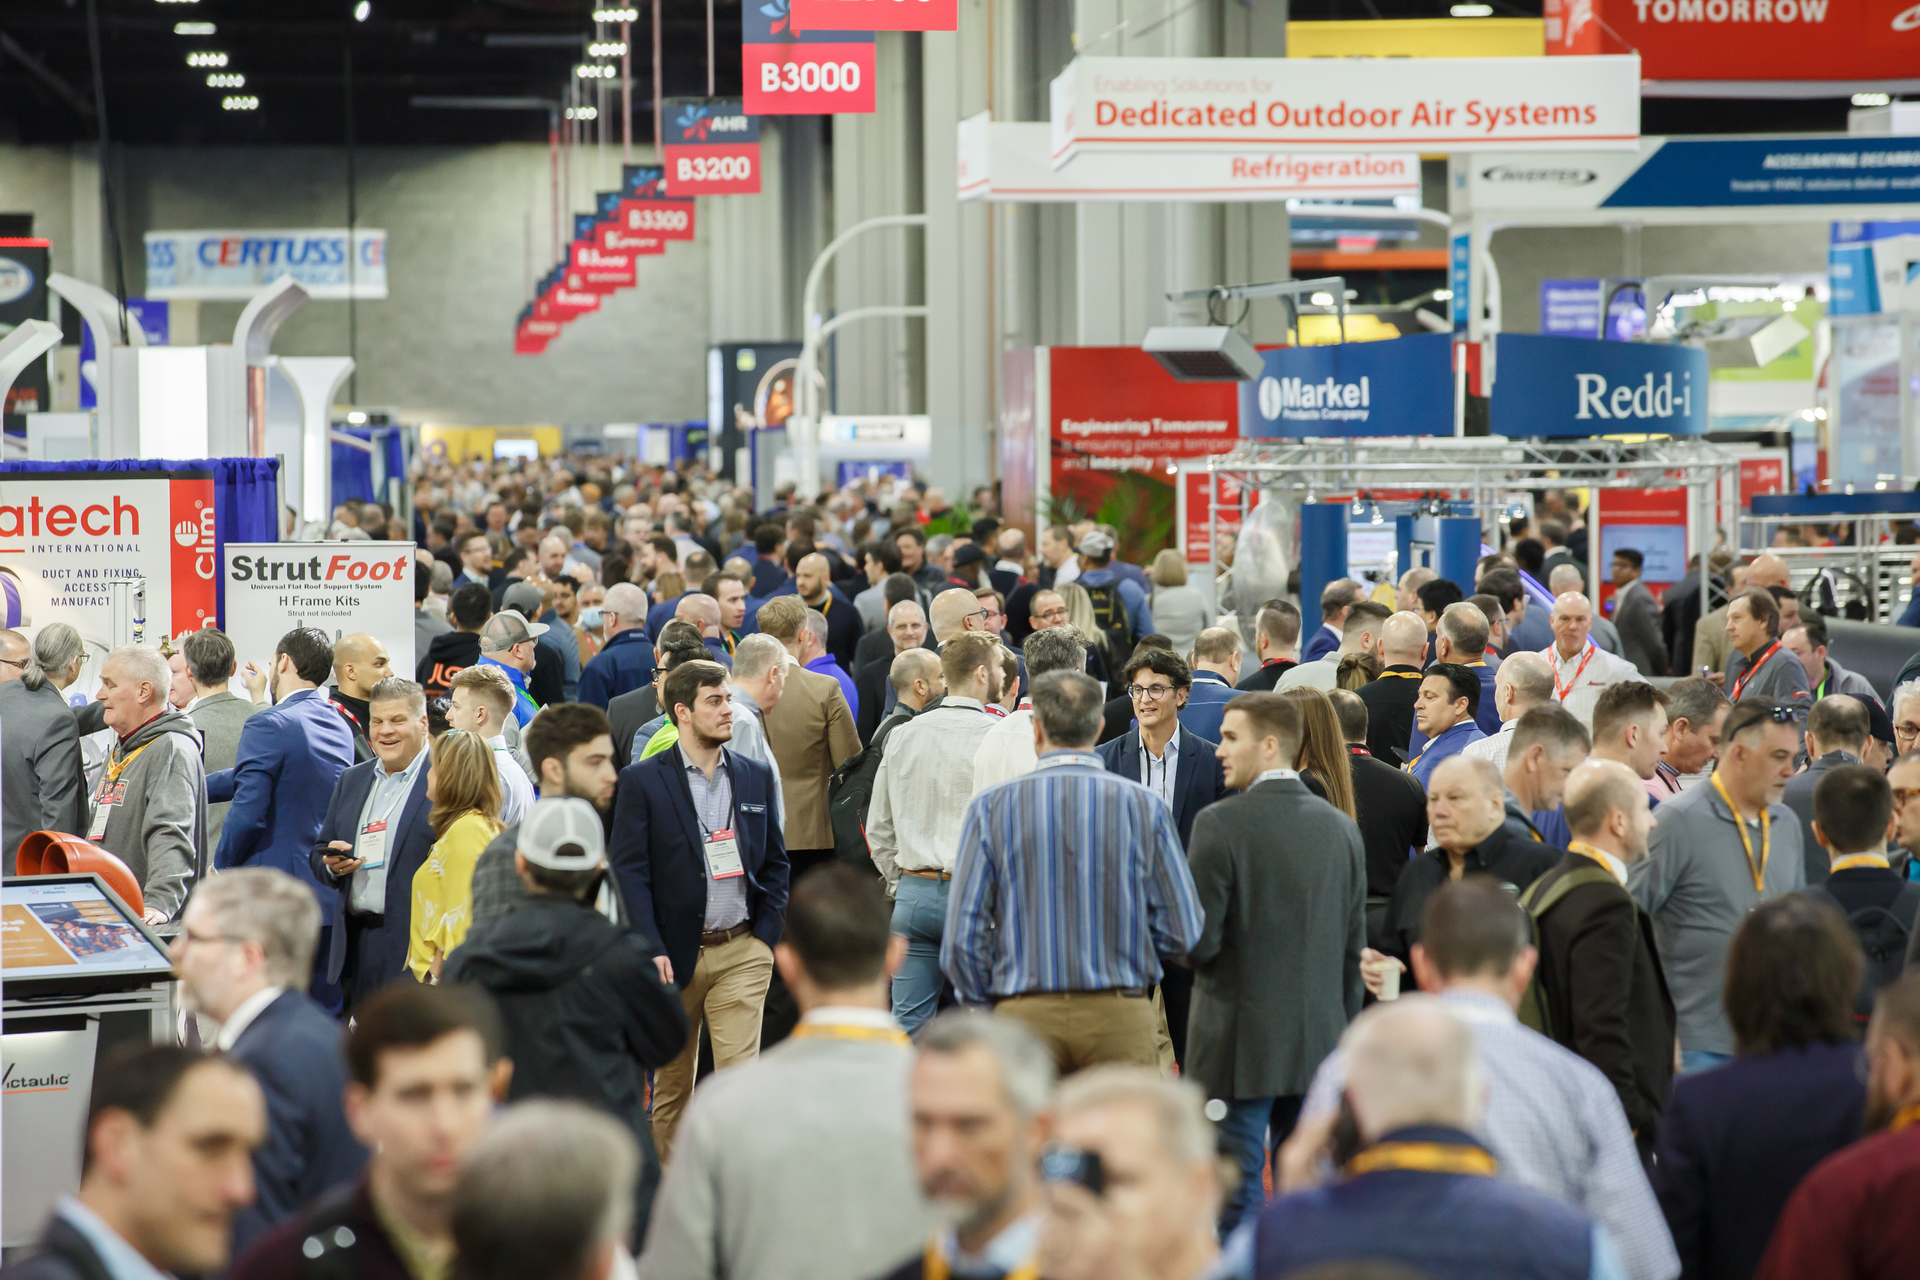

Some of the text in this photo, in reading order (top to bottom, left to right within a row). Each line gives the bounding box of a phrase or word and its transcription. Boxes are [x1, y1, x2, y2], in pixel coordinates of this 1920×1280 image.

[1634, 0, 1826, 23] TOMORROW
[761, 61, 861, 93] B3000
[1094, 75, 1273, 97] Enabling Solutions for
[710, 115, 748, 132] AHR
[1096, 100, 1597, 133] Dedicated Outdoor Air Systems
[677, 156, 751, 182] B3200
[1231, 156, 1405, 184] Refrigeration
[628, 208, 688, 230] B3300
[197, 237, 346, 268] CERTUSS
[1281, 376, 1370, 409] Markel
[1574, 370, 1692, 420] Redd-i
[1282, 408, 1370, 422] Products Company
[1061, 417, 1229, 436] Engineering Tomorrow
[1074, 438, 1133, 453] ensuring
[1134, 438, 1181, 453] precise
[1060, 457, 1087, 470] and
[1089, 455, 1155, 473] integrity
[0, 495, 140, 538] atech
[31, 543, 141, 554] INTERNATIONAL
[42, 568, 140, 579] DUCT AND FIXING
[64, 582, 110, 592] ACCESS
[279, 595, 360, 606] H Frame Kits
